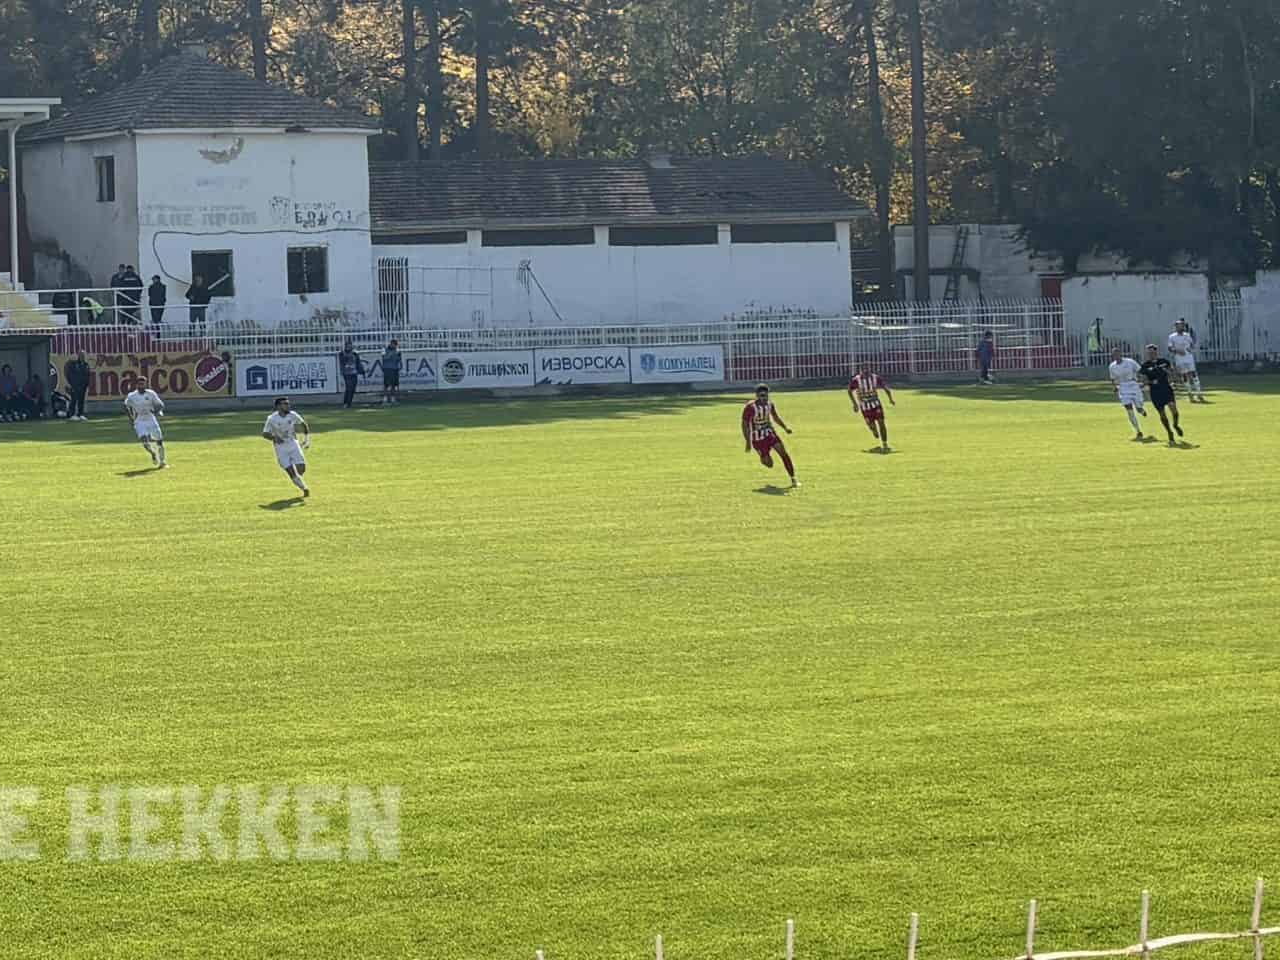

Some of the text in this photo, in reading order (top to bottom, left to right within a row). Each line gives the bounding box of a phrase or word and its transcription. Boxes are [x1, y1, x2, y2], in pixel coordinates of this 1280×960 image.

[540, 355, 626, 372] ИЗВОРСКА
[657, 356, 716, 370] КОМУНАЛЕЦ
[86, 363, 189, 396] inalco
[271, 378, 328, 390] ПРОМЕТ
